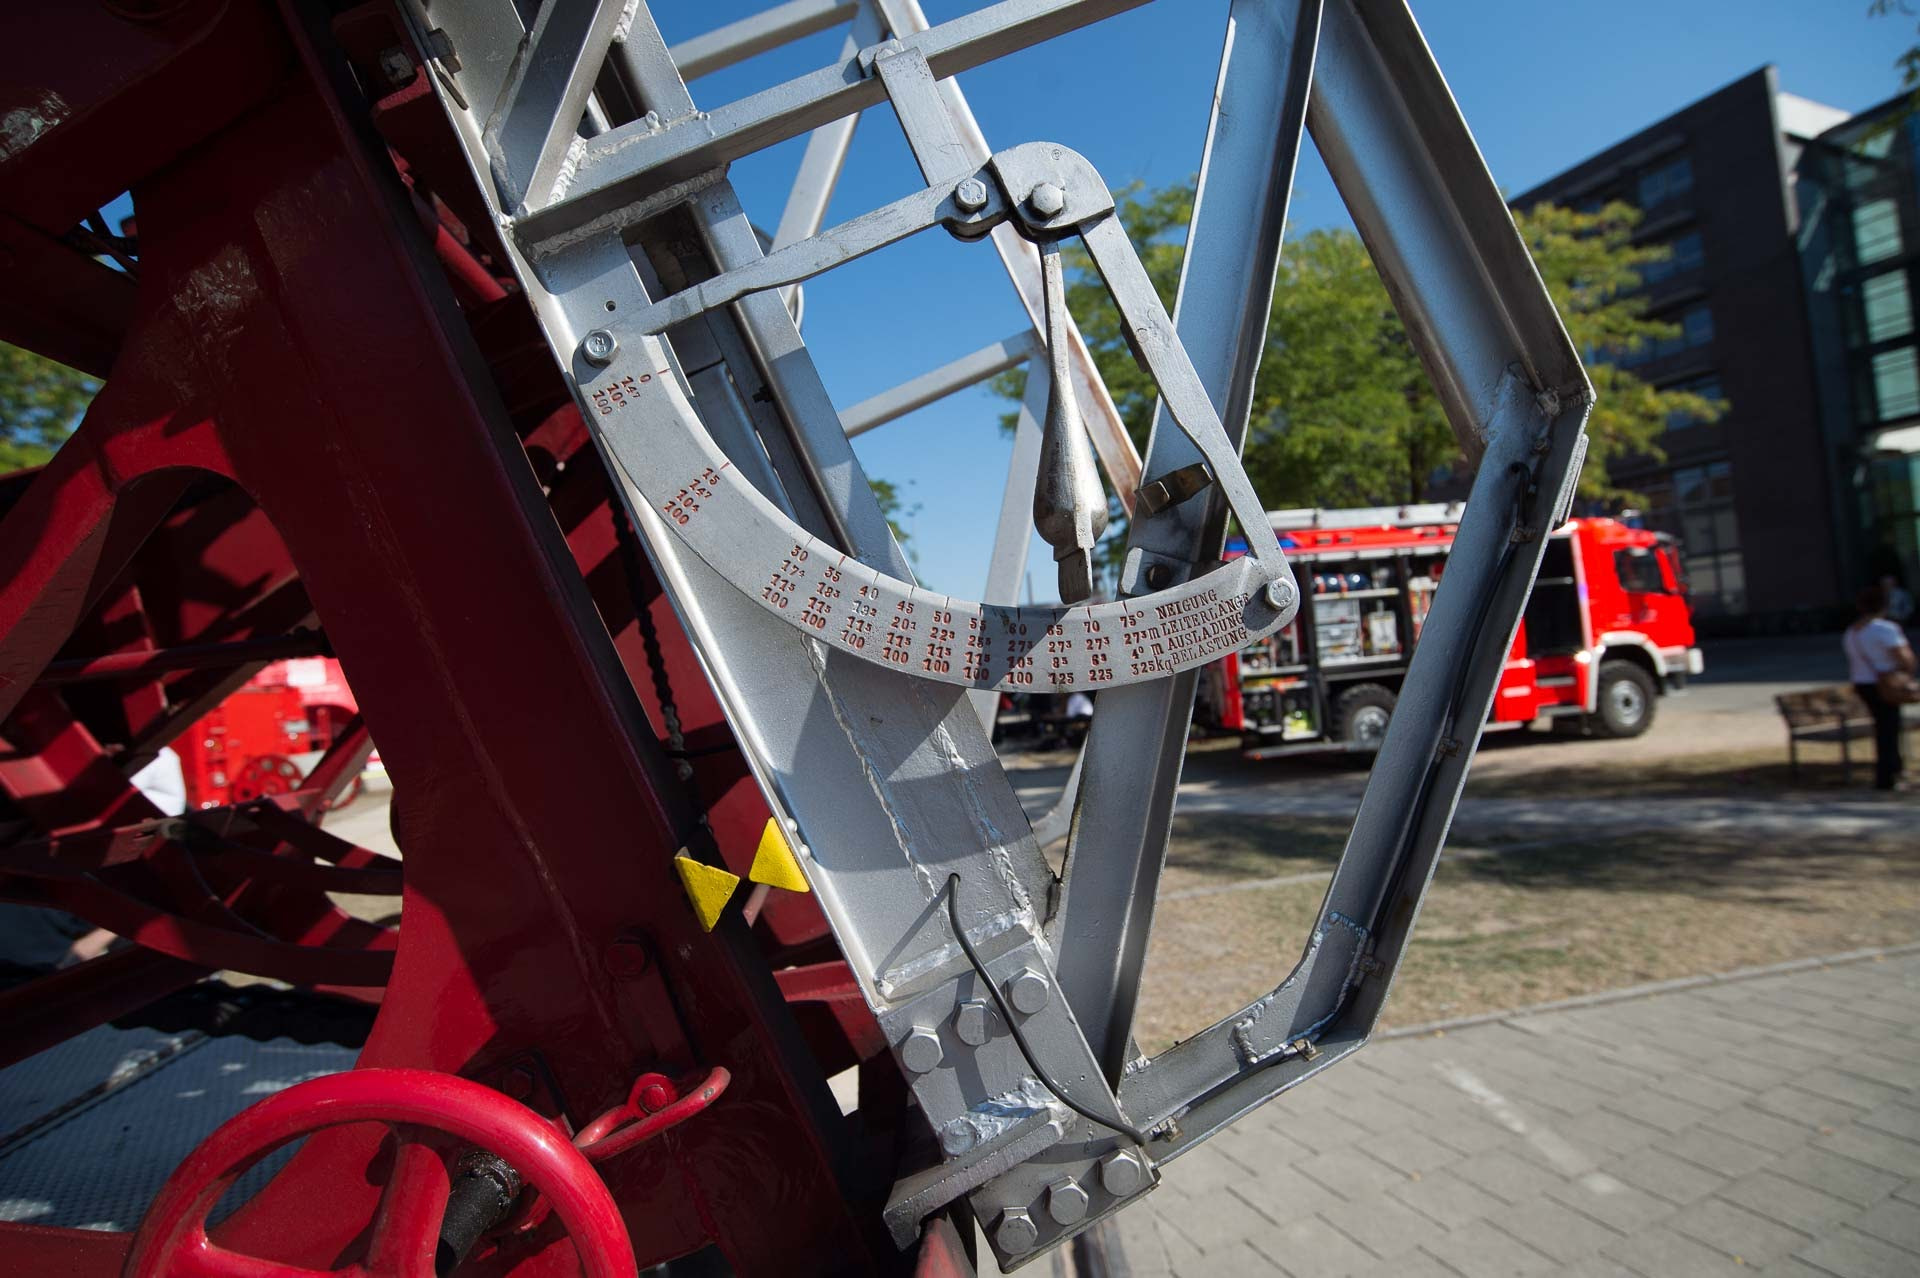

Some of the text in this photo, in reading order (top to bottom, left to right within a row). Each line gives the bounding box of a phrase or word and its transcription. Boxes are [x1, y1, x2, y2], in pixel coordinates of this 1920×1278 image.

[639, 374, 651, 383] 0
[592, 390, 612, 415] 100
[702, 468, 720, 485] 15
[663, 501, 689, 525] 100
[790, 545, 808, 561] 30
[824, 566, 842, 582] 35
[761, 587, 788, 608] 100
[859, 586, 879, 600] 40
[897, 600, 914, 615] 45
[1155, 589, 1218, 620] NEIGUNG
[801, 610, 826, 630] 100
[934, 611, 951, 624] 50
[969, 618, 986, 631] 55
[1009, 623, 1027, 635] 60
[1047, 625, 1063, 636] 65
[1084, 621, 1100, 633] 70
[1168, 612, 1243, 650] AUSLADUNG
[841, 630, 865, 649] 100
[1170, 627, 1247, 665] BELASTUNG
[882, 647, 909, 664] 100
[923, 659, 950, 673] 100
[963, 667, 990, 680] 100
[1006, 672, 1033, 685] 100
[1048, 673, 1074, 684] 125
[1089, 669, 1113, 681] 225
